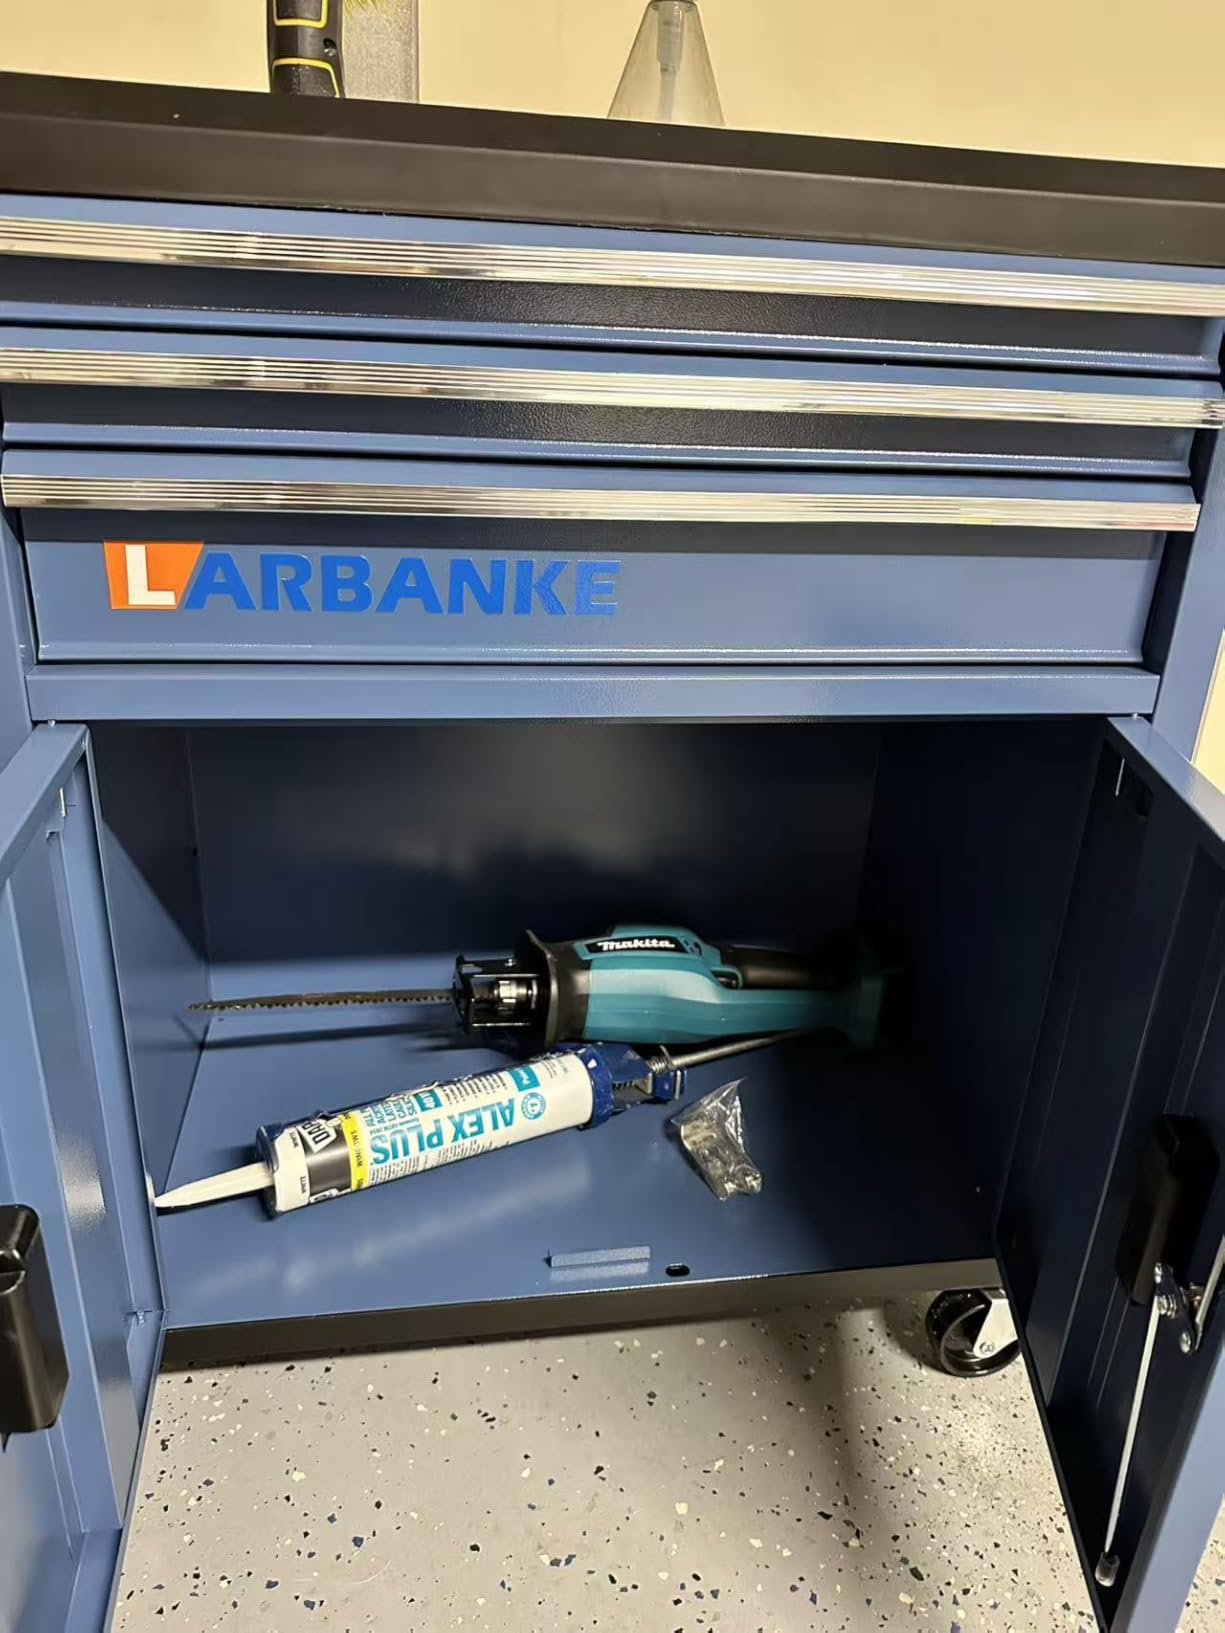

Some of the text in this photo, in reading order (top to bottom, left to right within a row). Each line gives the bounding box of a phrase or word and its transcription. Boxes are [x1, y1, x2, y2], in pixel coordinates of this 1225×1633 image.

[124, 543, 622, 616] LARBANKE
[370, 1118, 444, 1165] PLUS
[447, 1098, 515, 1143] ALEX
